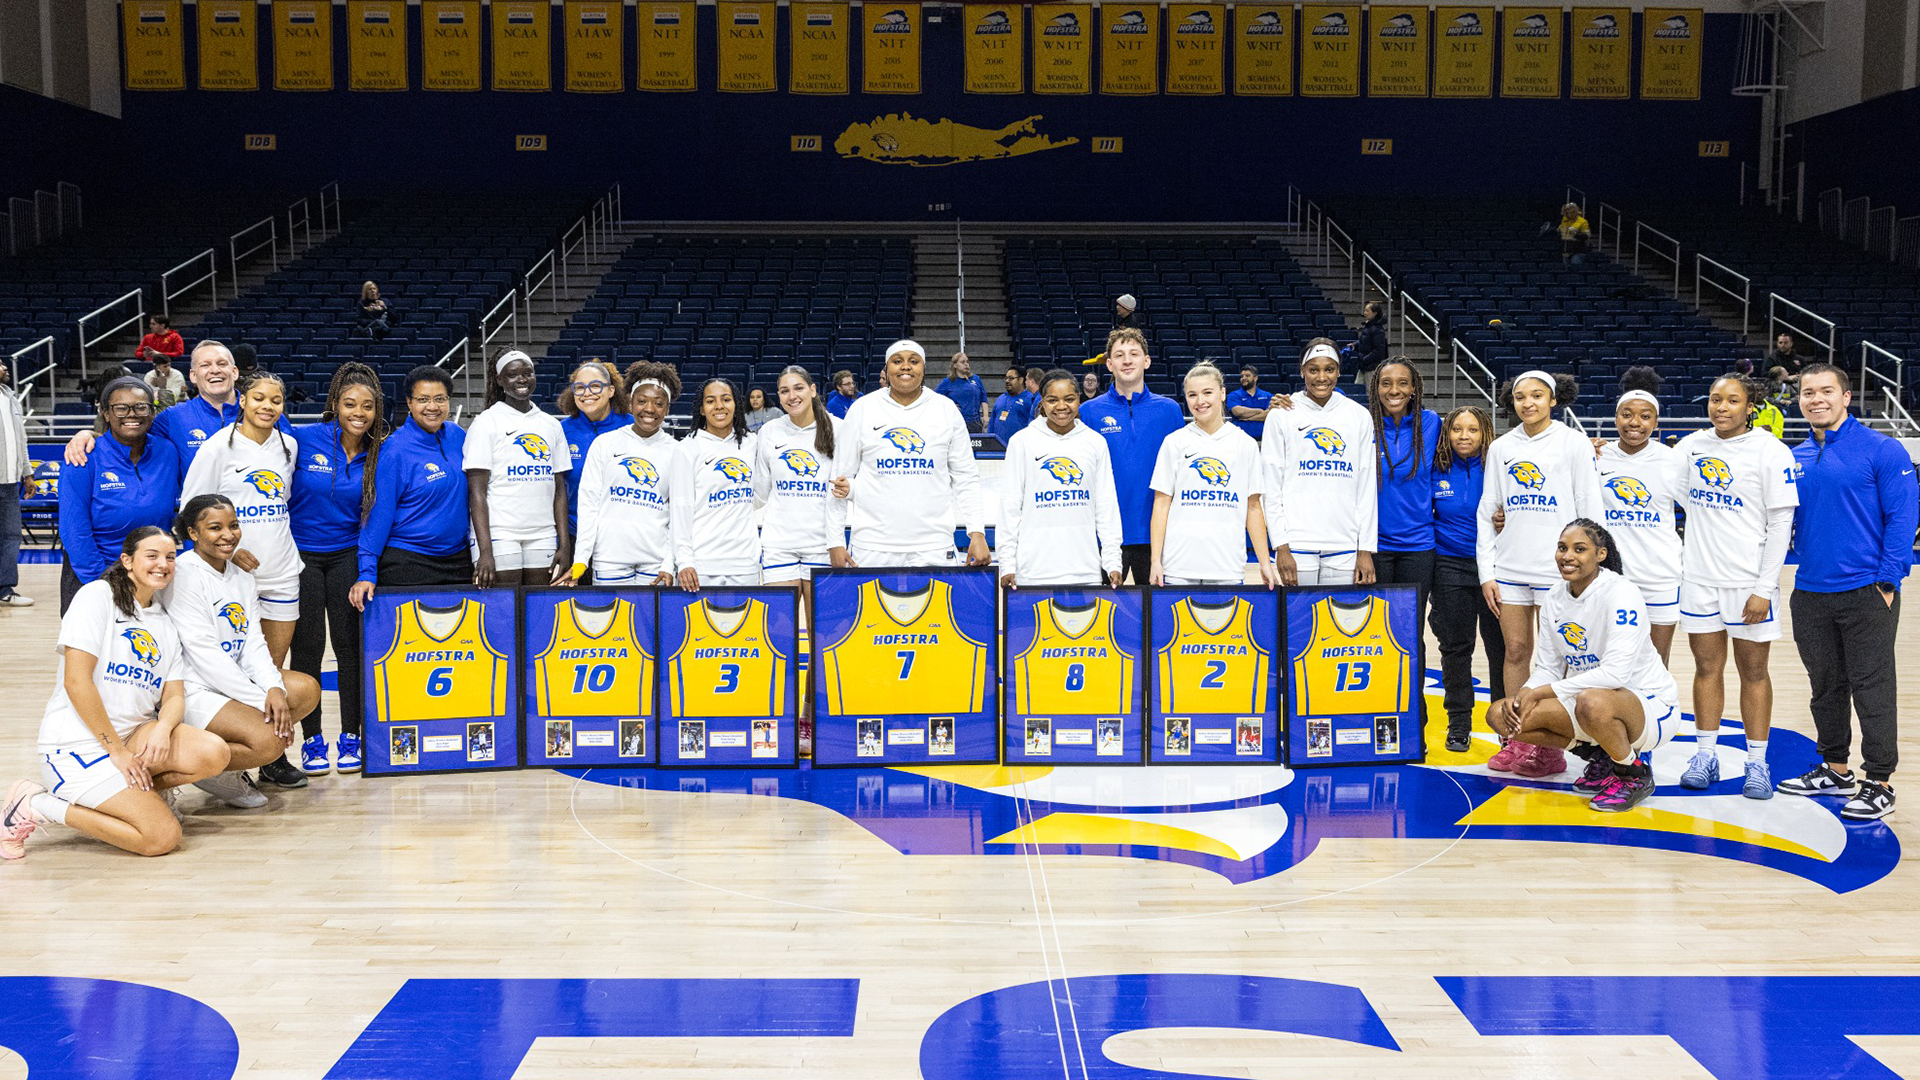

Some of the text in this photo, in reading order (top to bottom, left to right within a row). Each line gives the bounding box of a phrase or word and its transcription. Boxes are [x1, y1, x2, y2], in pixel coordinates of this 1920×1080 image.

[136, 27, 170, 36] NCAA
[210, 27, 245, 37] NCAA
[285, 28, 320, 38] NCAA
[361, 28, 394, 38] NCAA
[434, 28, 469, 38] NCAA
[504, 28, 538, 38] NCAA
[976, 24, 1011, 32] HOFSTRA
[1045, 26, 1080, 34] HOFSTRA
[1112, 24, 1147, 32] HOFSTRA
[1248, 25, 1283, 33] HOFSTRA
[1313, 26, 1348, 34] HOFSTRA
[1382, 27, 1417, 35] HOFSTRA
[1448, 26, 1482, 34] HOFSTRA
[654, 29, 680, 38] NIT
[730, 29, 764, 39] NCAA
[802, 30, 837, 40] NCAA
[880, 38, 906, 48] NIT
[982, 39, 1007, 49] NIT
[1044, 40, 1082, 50] WNIT
[1116, 40, 1142, 50] NIT
[1176, 40, 1216, 50] WNIT
[1246, 41, 1282, 51] WNIT
[1314, 41, 1349, 52] WNIT
[1382, 42, 1417, 52] WNIT
[1452, 43, 1477, 53] NIT
[1515, 43, 1548, 53] WNIT
[1588, 44, 1615, 54] NIT
[1659, 44, 1685, 54] NIT
[250, 137, 270, 146] 108
[520, 138, 542, 148] 109
[798, 138, 816, 149] 110
[1100, 140, 1116, 151] 111
[1368, 141, 1386, 151] 112
[1704, 143, 1723, 154] 113
[877, 458, 934, 468] HOFSTRA
[1300, 460, 1353, 472] HOFSTRA
[1035, 490, 1090, 502] HOFSTRA
[1181, 490, 1239, 502] HOFSTRA
[1616, 609, 1638, 626] 32
[873, 634, 939, 645] HOFSTRA
[560, 648, 628, 660] HOFSTRA
[694, 648, 760, 659] HOFSTRA
[1041, 647, 1107, 658] HOFSTRA
[1180, 644, 1248, 655] HOFSTRA
[1322, 646, 1383, 658] HOFSTRA
[405, 650, 475, 662] HOFSTRA
[896, 650, 915, 680] 7
[572, 664, 616, 694] 10
[714, 663, 740, 694] 3
[1065, 663, 1084, 692] 8
[1199, 660, 1226, 689] 2
[1334, 662, 1371, 692] 13
[426, 666, 454, 697] 6
